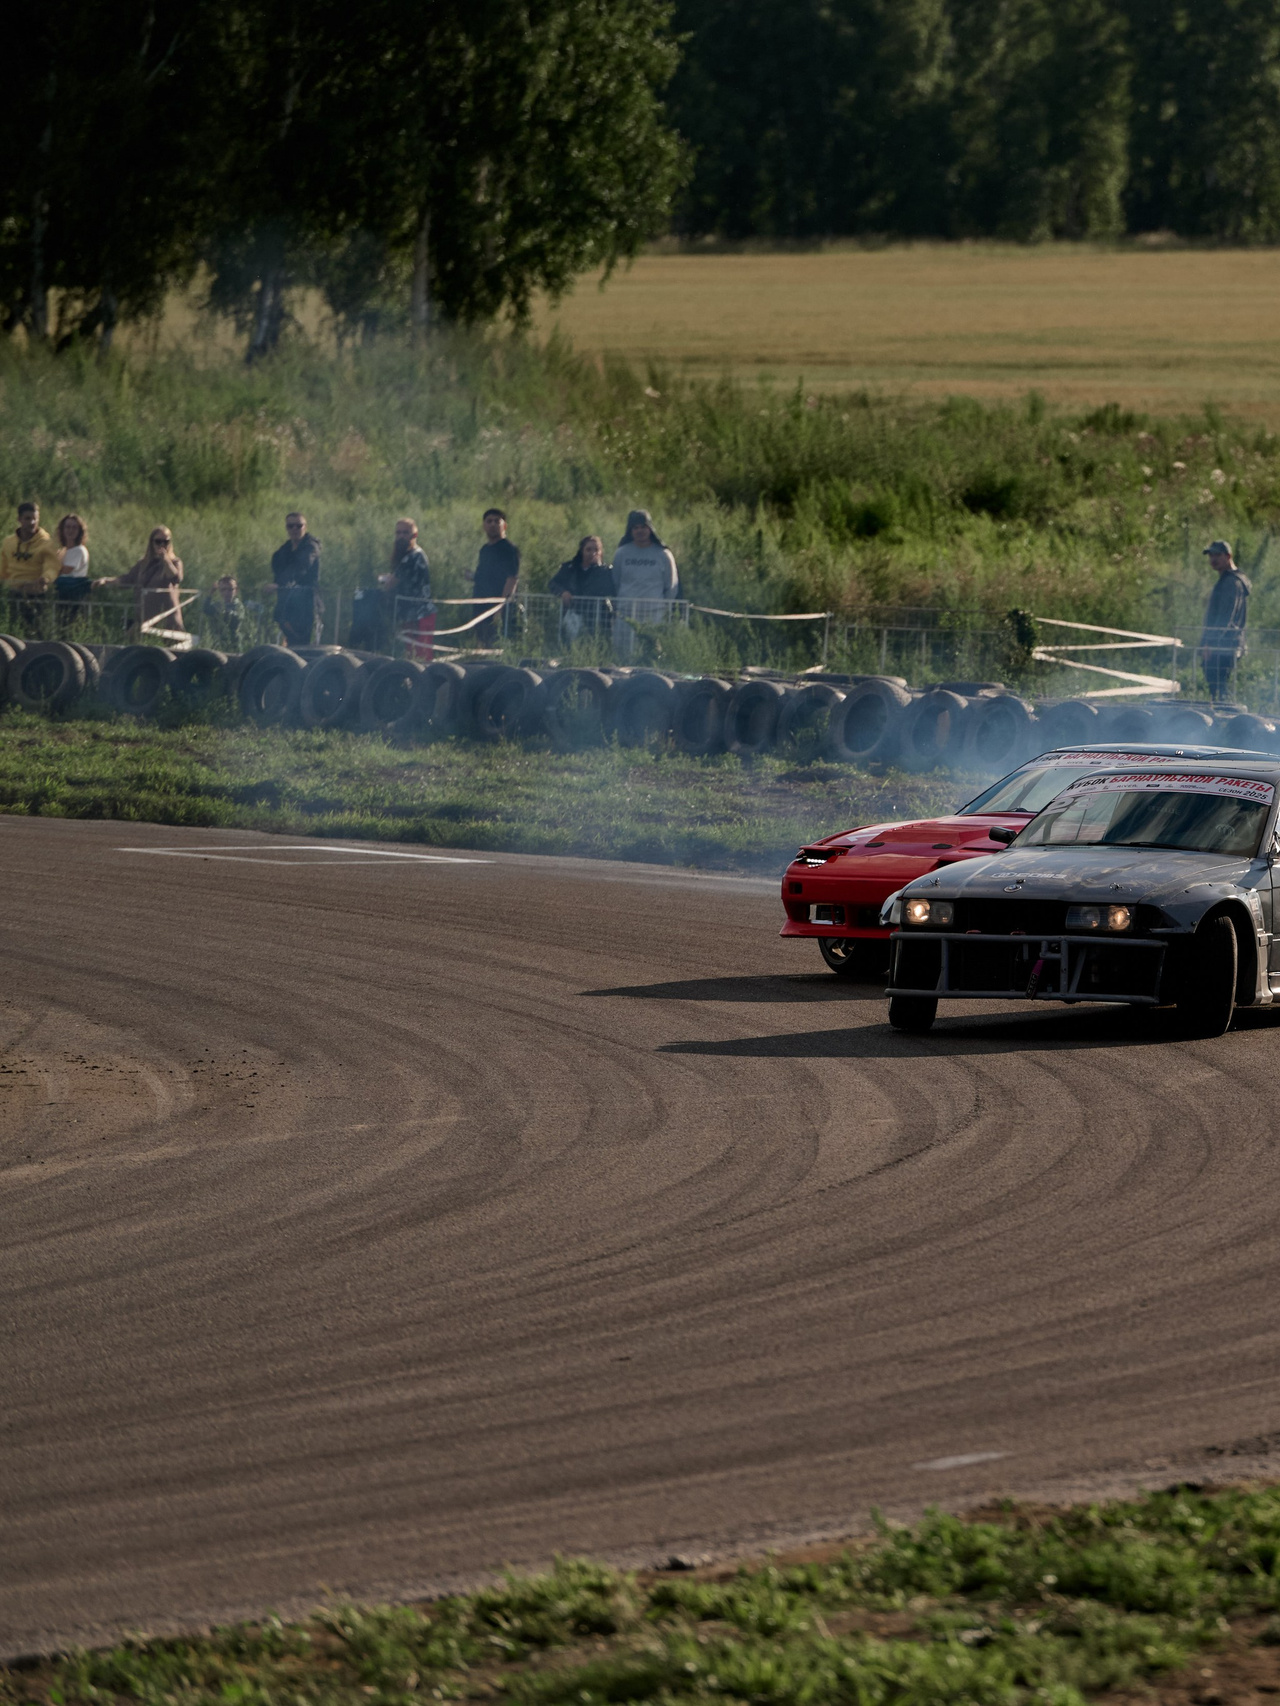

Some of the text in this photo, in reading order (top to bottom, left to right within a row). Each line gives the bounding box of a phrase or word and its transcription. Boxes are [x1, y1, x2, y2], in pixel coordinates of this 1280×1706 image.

[1066, 777, 1109, 791] КУБОК
[1215, 778, 1272, 792] РАКЕТЫ
[1218, 787, 1268, 799] СЕЗОН 2025
